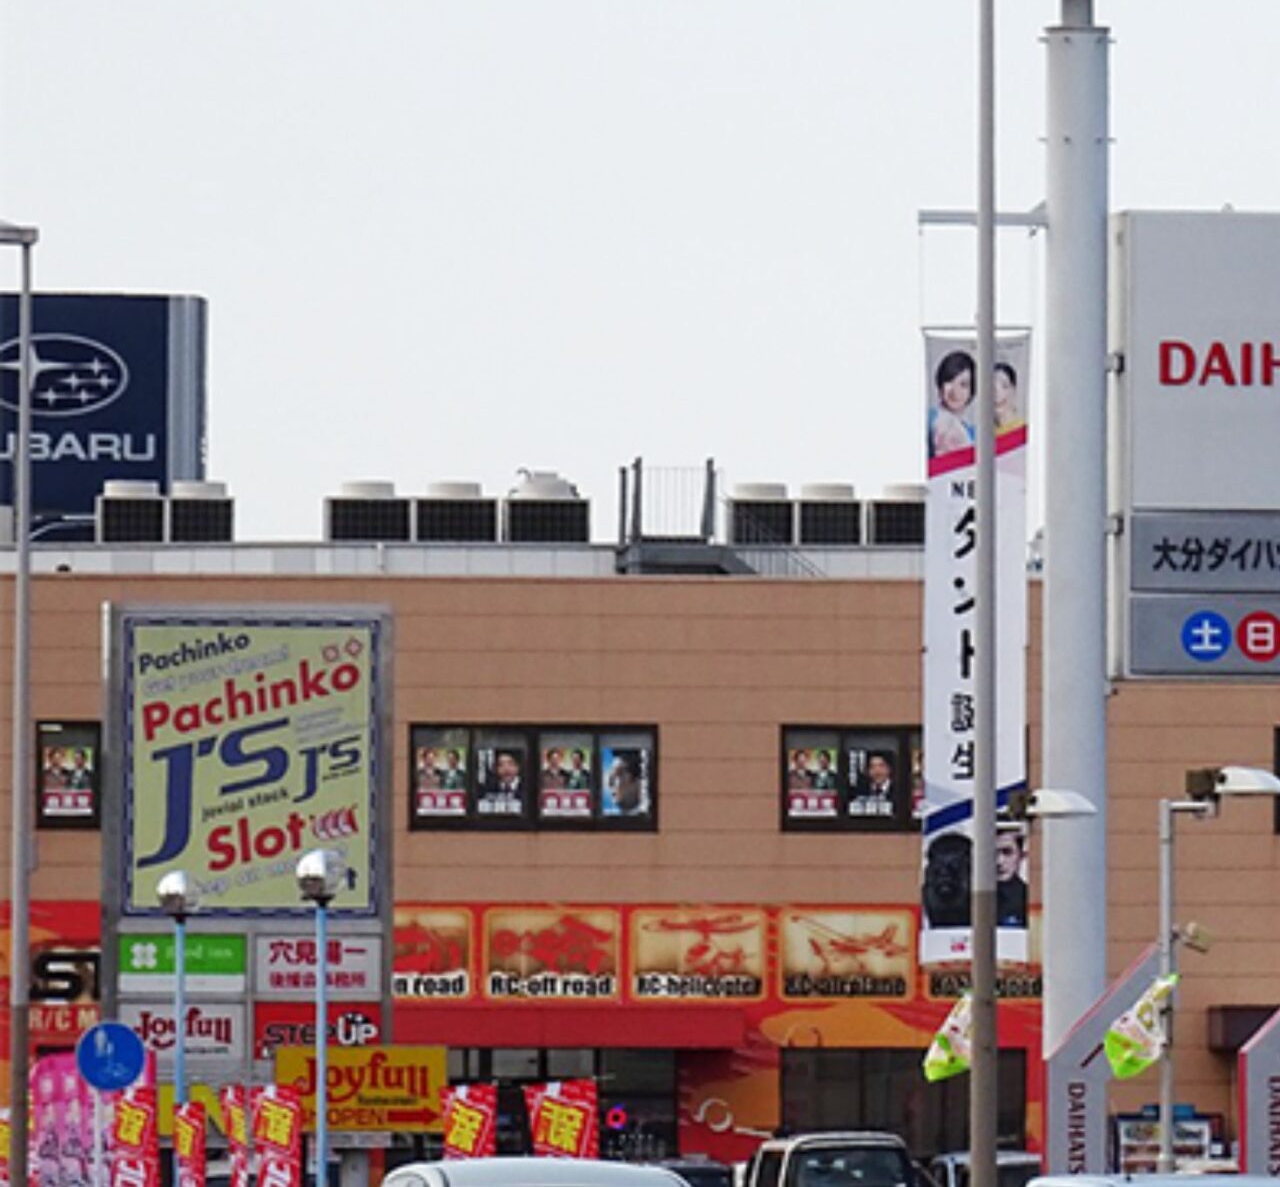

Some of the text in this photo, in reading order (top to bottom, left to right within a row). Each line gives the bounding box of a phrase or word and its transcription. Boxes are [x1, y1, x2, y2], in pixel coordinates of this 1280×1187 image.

[139, 632, 250, 675] Pachinko
[142, 659, 361, 741] Pachinko
[207, 813, 305, 871] Slot
[413, 972, 467, 995] road
[563, 973, 613, 996] road
[294, 1052, 429, 1103] Joyfull
